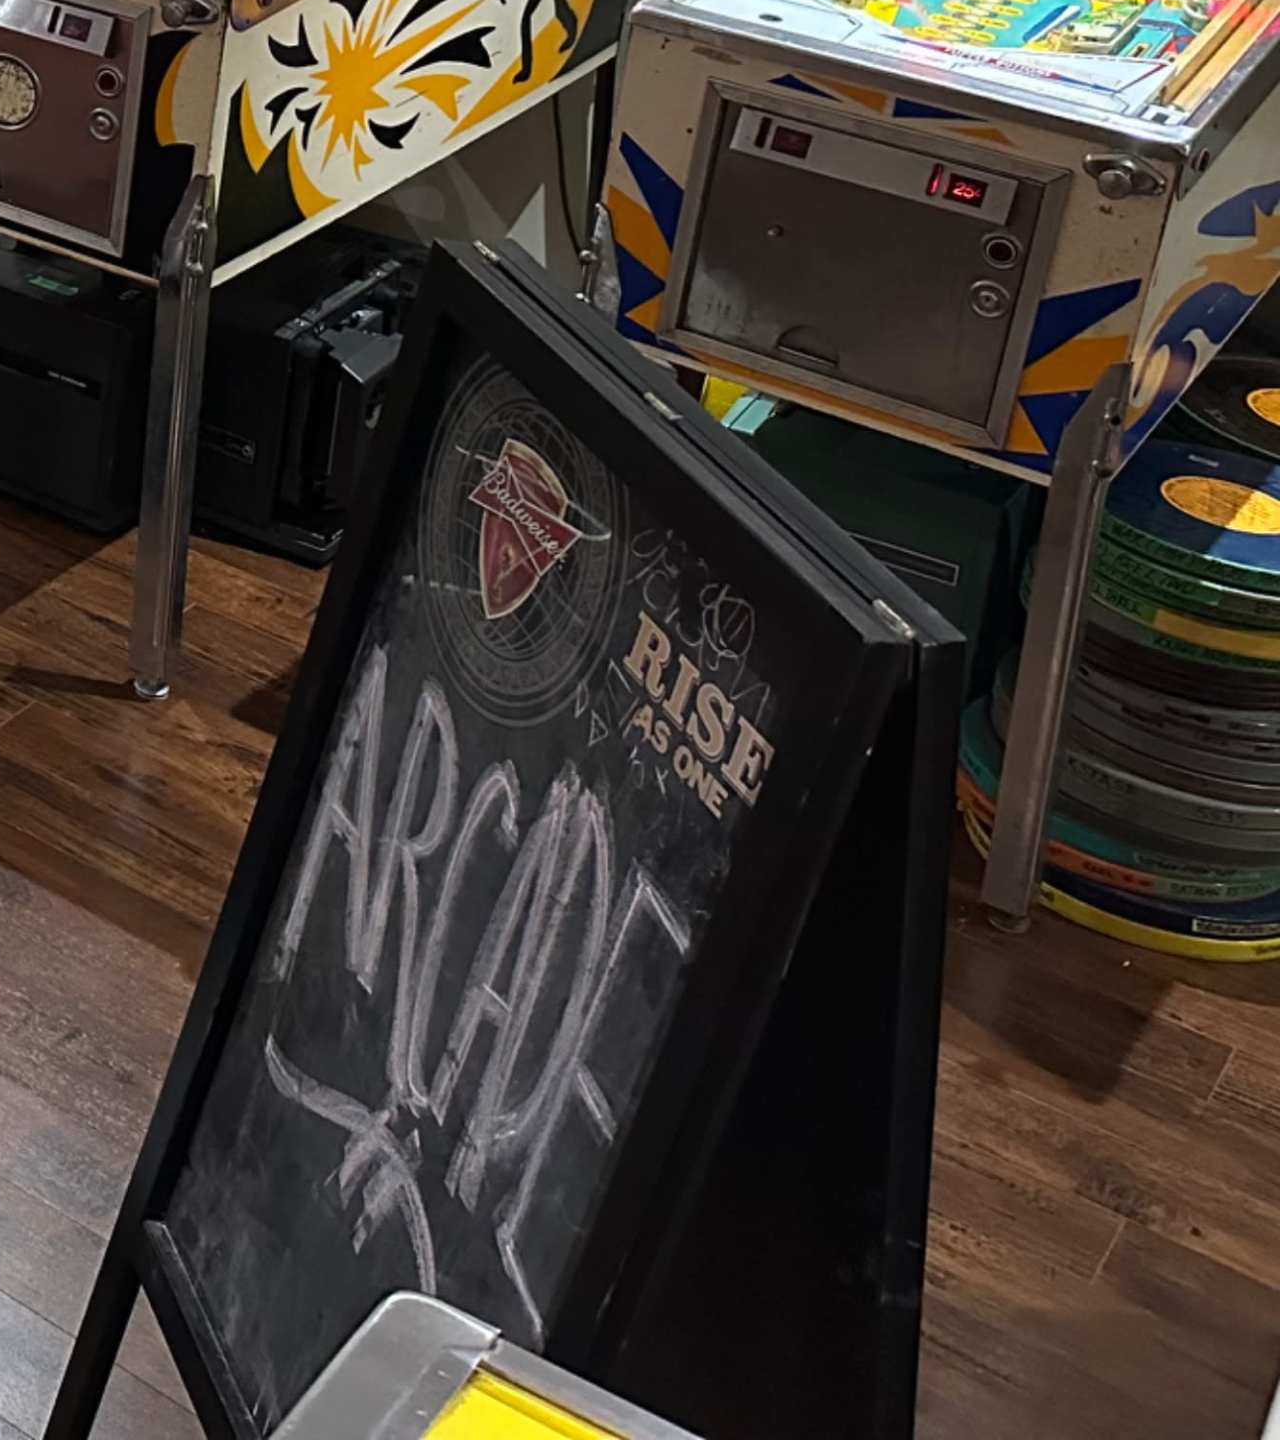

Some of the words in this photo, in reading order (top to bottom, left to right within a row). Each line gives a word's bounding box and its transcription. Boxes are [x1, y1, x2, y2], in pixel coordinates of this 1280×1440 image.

[622, 703, 673, 755] AS
[673, 744, 729, 821] ONE
[623, 610, 775, 808] RISE
